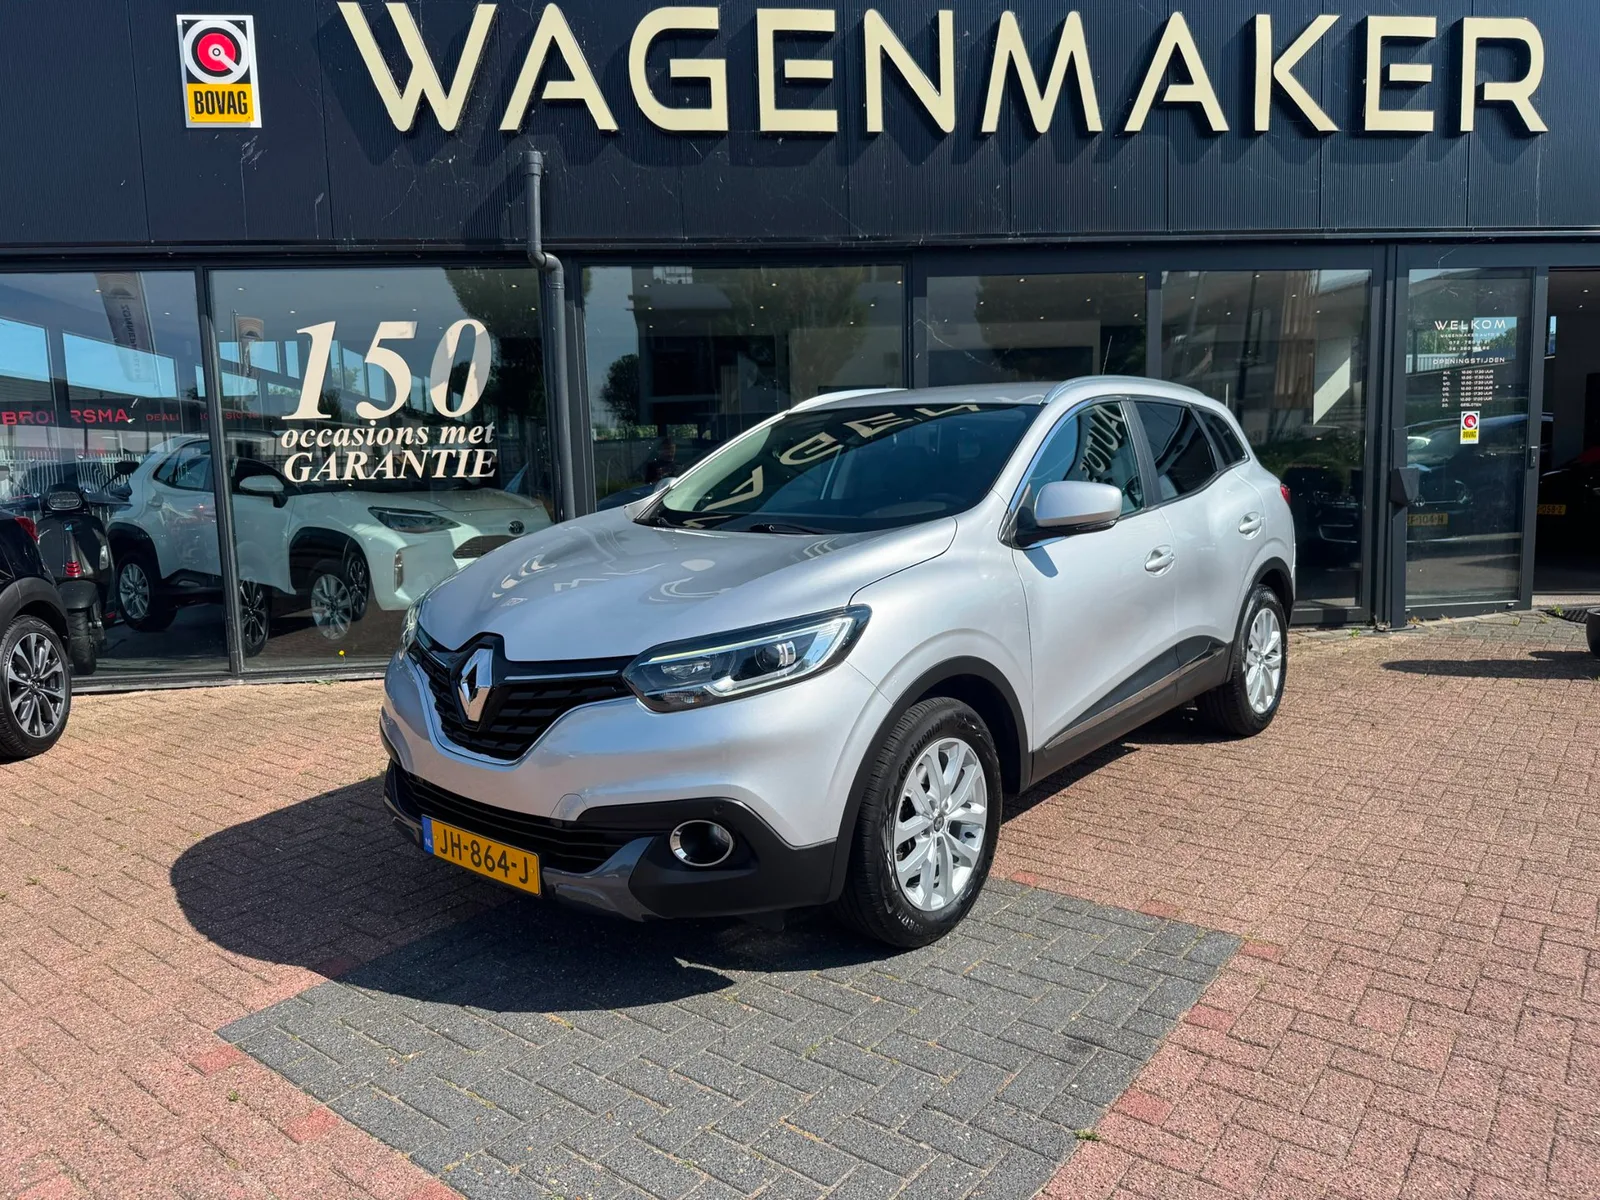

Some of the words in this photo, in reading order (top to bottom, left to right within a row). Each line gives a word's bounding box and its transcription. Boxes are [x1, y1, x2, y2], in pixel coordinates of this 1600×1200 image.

[337, 2, 1549, 132] WAGENMAKER
[193, 90, 248, 115] BOVAG
[1434, 319, 1506, 331] WELKOM
[281, 318, 492, 420] 150
[1433, 357, 1506, 365] OPENINGSTIJDEN
[1, 409, 129, 425] BRORSMA
[281, 420, 429, 448] occasions
[439, 421, 495, 444] met
[284, 449, 497, 482] GARANTIE
[899, 719, 944, 781] Continental
[440, 829, 529, 884] JH-864-J
